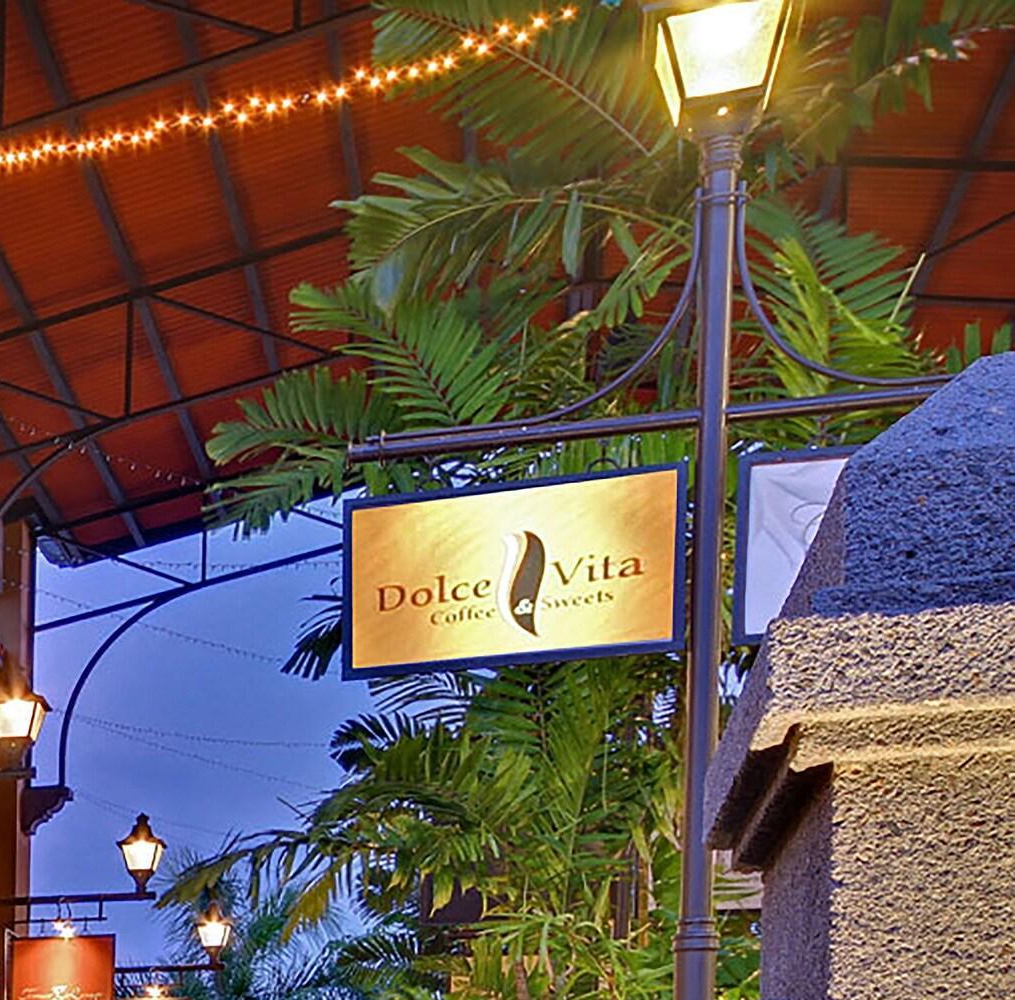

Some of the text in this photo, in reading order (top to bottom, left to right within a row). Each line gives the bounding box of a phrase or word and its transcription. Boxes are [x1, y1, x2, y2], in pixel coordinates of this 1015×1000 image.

[377, 554, 645, 612] Dolce Vita
[430, 606, 496, 626] Coffee
[542, 589, 615, 609] Sweets
